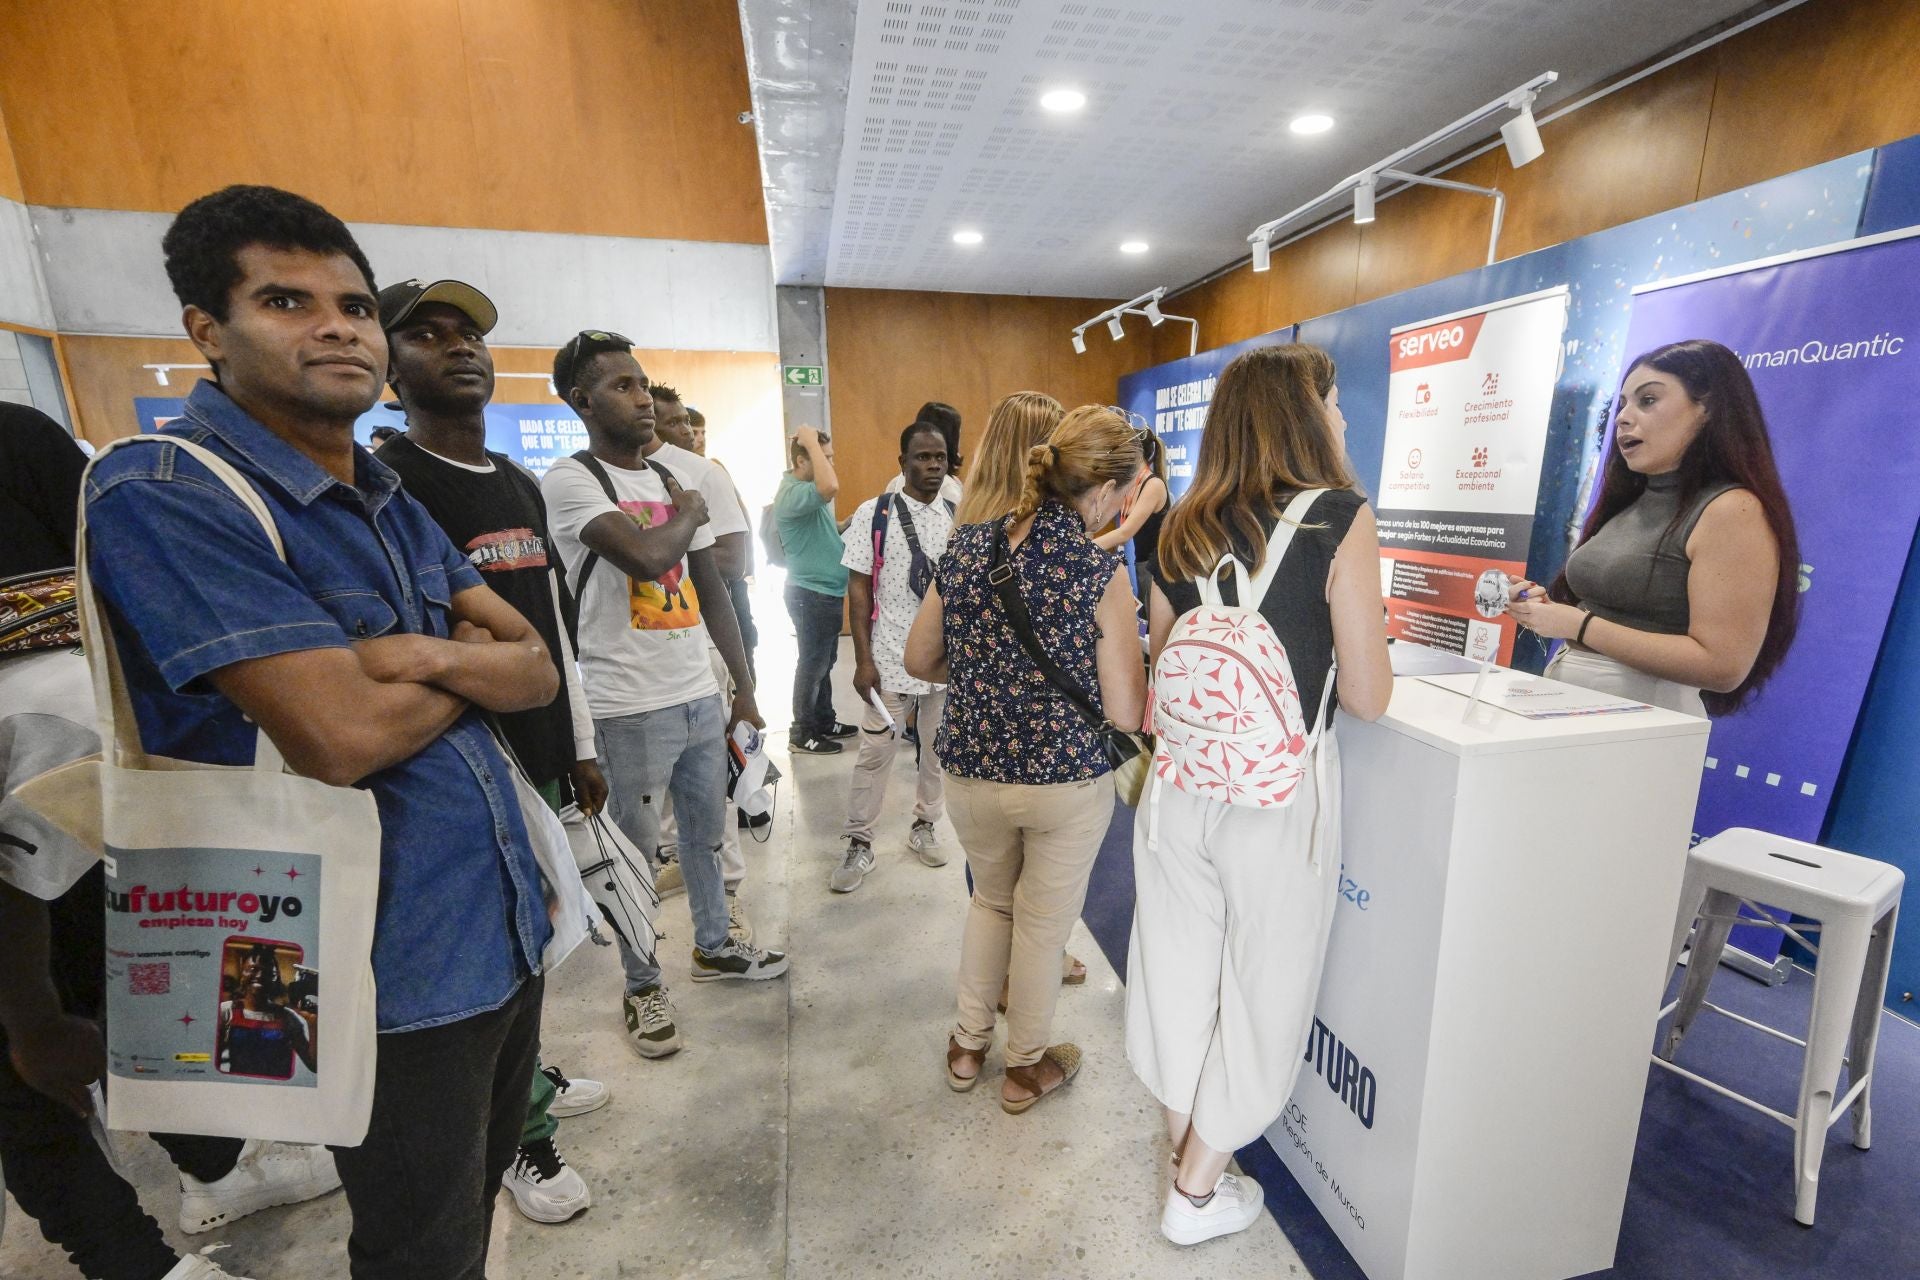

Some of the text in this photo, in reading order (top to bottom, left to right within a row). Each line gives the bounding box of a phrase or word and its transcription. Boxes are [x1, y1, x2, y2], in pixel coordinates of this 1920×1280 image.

[1399, 325, 1464, 358] serveo
[1735, 332, 1904, 369] umanQuantic
[1170, 385, 1178, 408] SE
[1399, 406, 1439, 419] Flexibilidad
[1464, 398, 1513, 413] Crecimiento
[1464, 410, 1509, 426] profesional
[519, 419, 545, 434] NADA
[544, 419, 557, 434] SE
[522, 434, 540, 451] QUE
[540, 434, 554, 449] UN
[1399, 470, 1424, 480] Salario
[1456, 468, 1502, 482] Excepcional
[1388, 480, 1430, 491] competitivo
[1458, 479, 1495, 491] ambiente
[1392, 520, 1404, 528] una
[1405, 519, 1412, 529] de
[1420, 520, 1430, 529] 100
[1430, 521, 1455, 532] mejores
[1455, 525, 1487, 534] empresas
[1487, 527, 1505, 536] para
[1398, 531, 1414, 542] según
[1414, 532, 1432, 541] Forbes
[1431, 535, 1436, 544] y
[1436, 533, 1470, 545] Actualidad
[1470, 536, 1506, 549] Económica
[139, 914, 248, 931] empieza hoy
[1283, 1115, 1365, 1231] Región de Murcia
